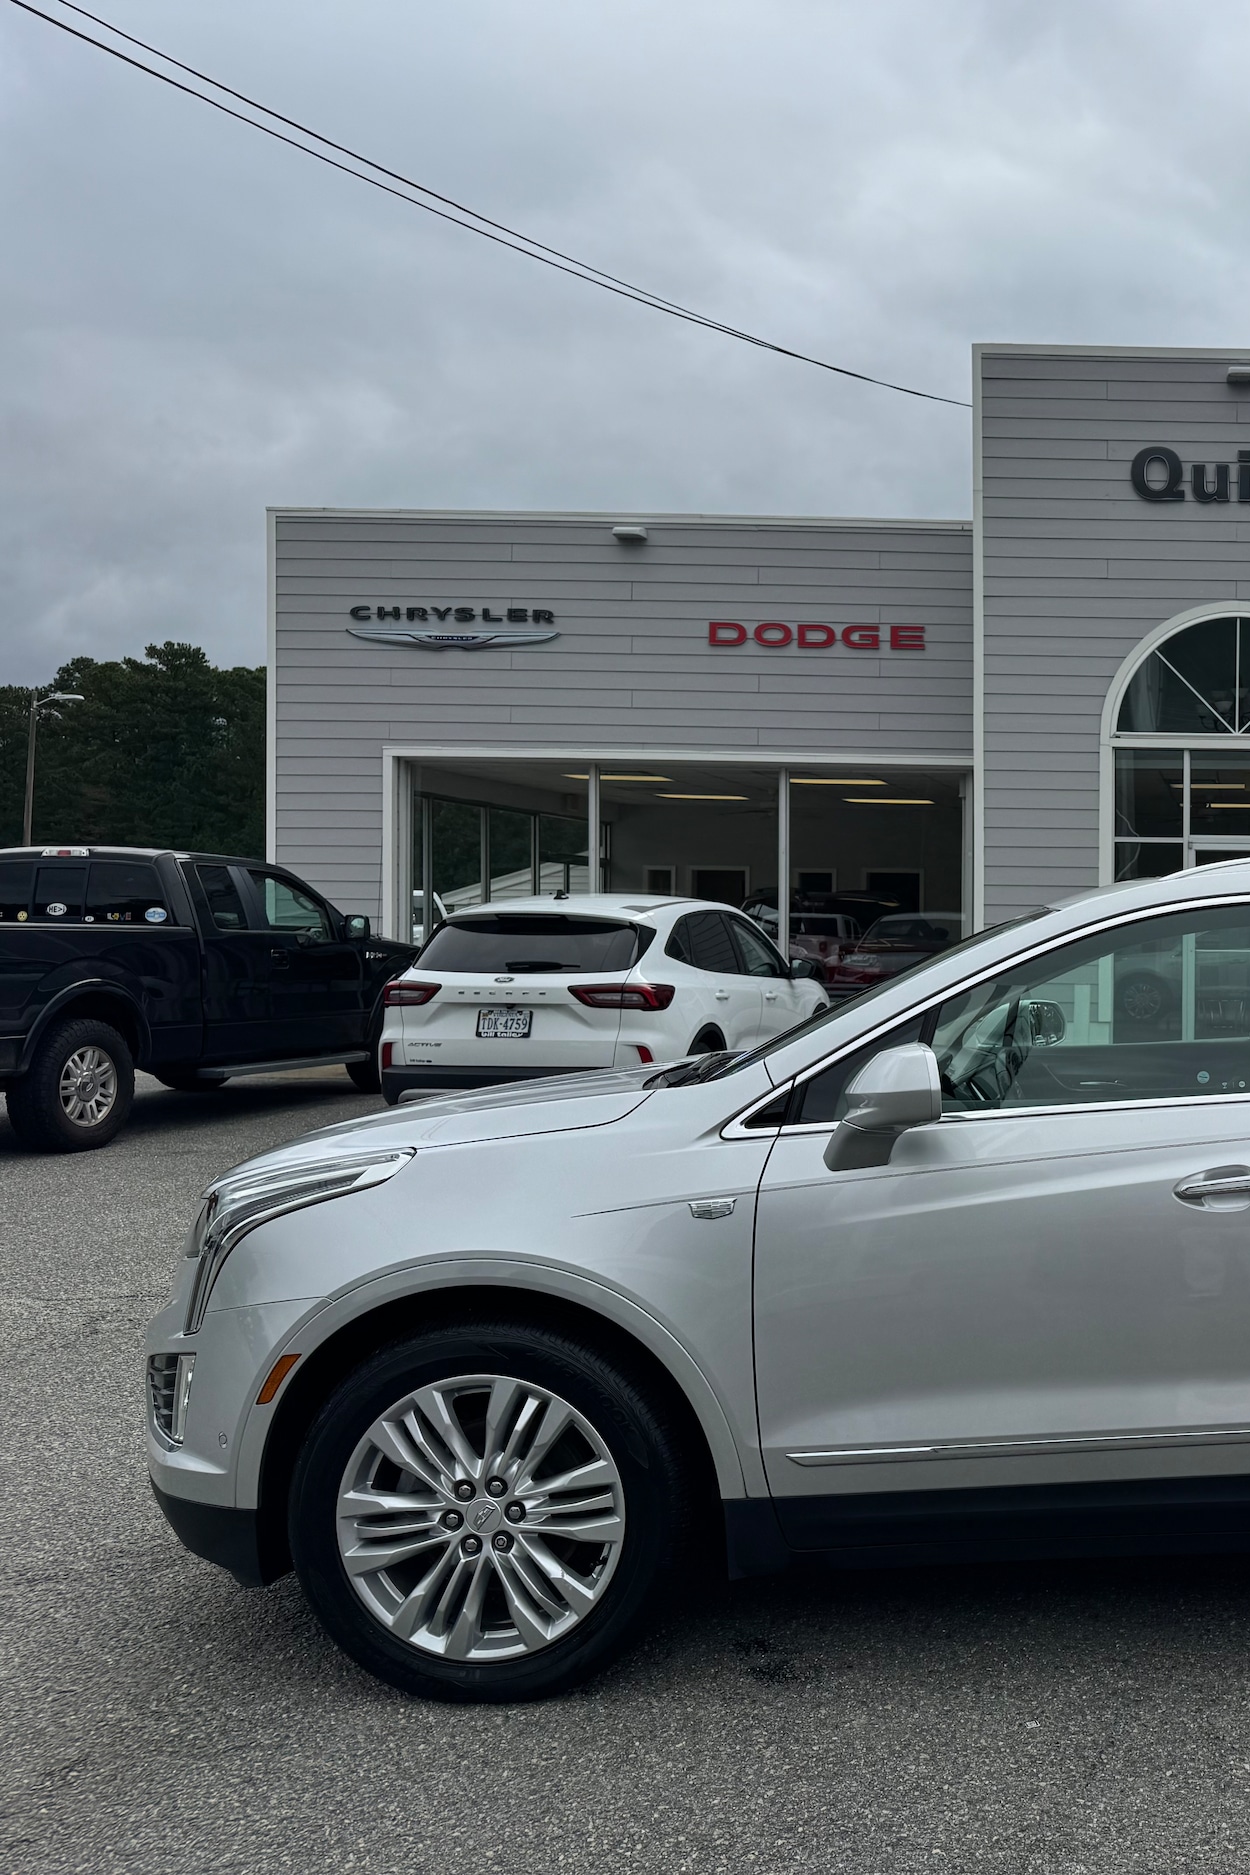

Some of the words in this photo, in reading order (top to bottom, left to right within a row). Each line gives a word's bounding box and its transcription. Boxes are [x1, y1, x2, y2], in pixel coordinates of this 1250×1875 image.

[350, 605, 555, 624] CHRYSLER
[708, 621, 925, 650] DODGE
[481, 1017, 528, 1031] TDK-4759
